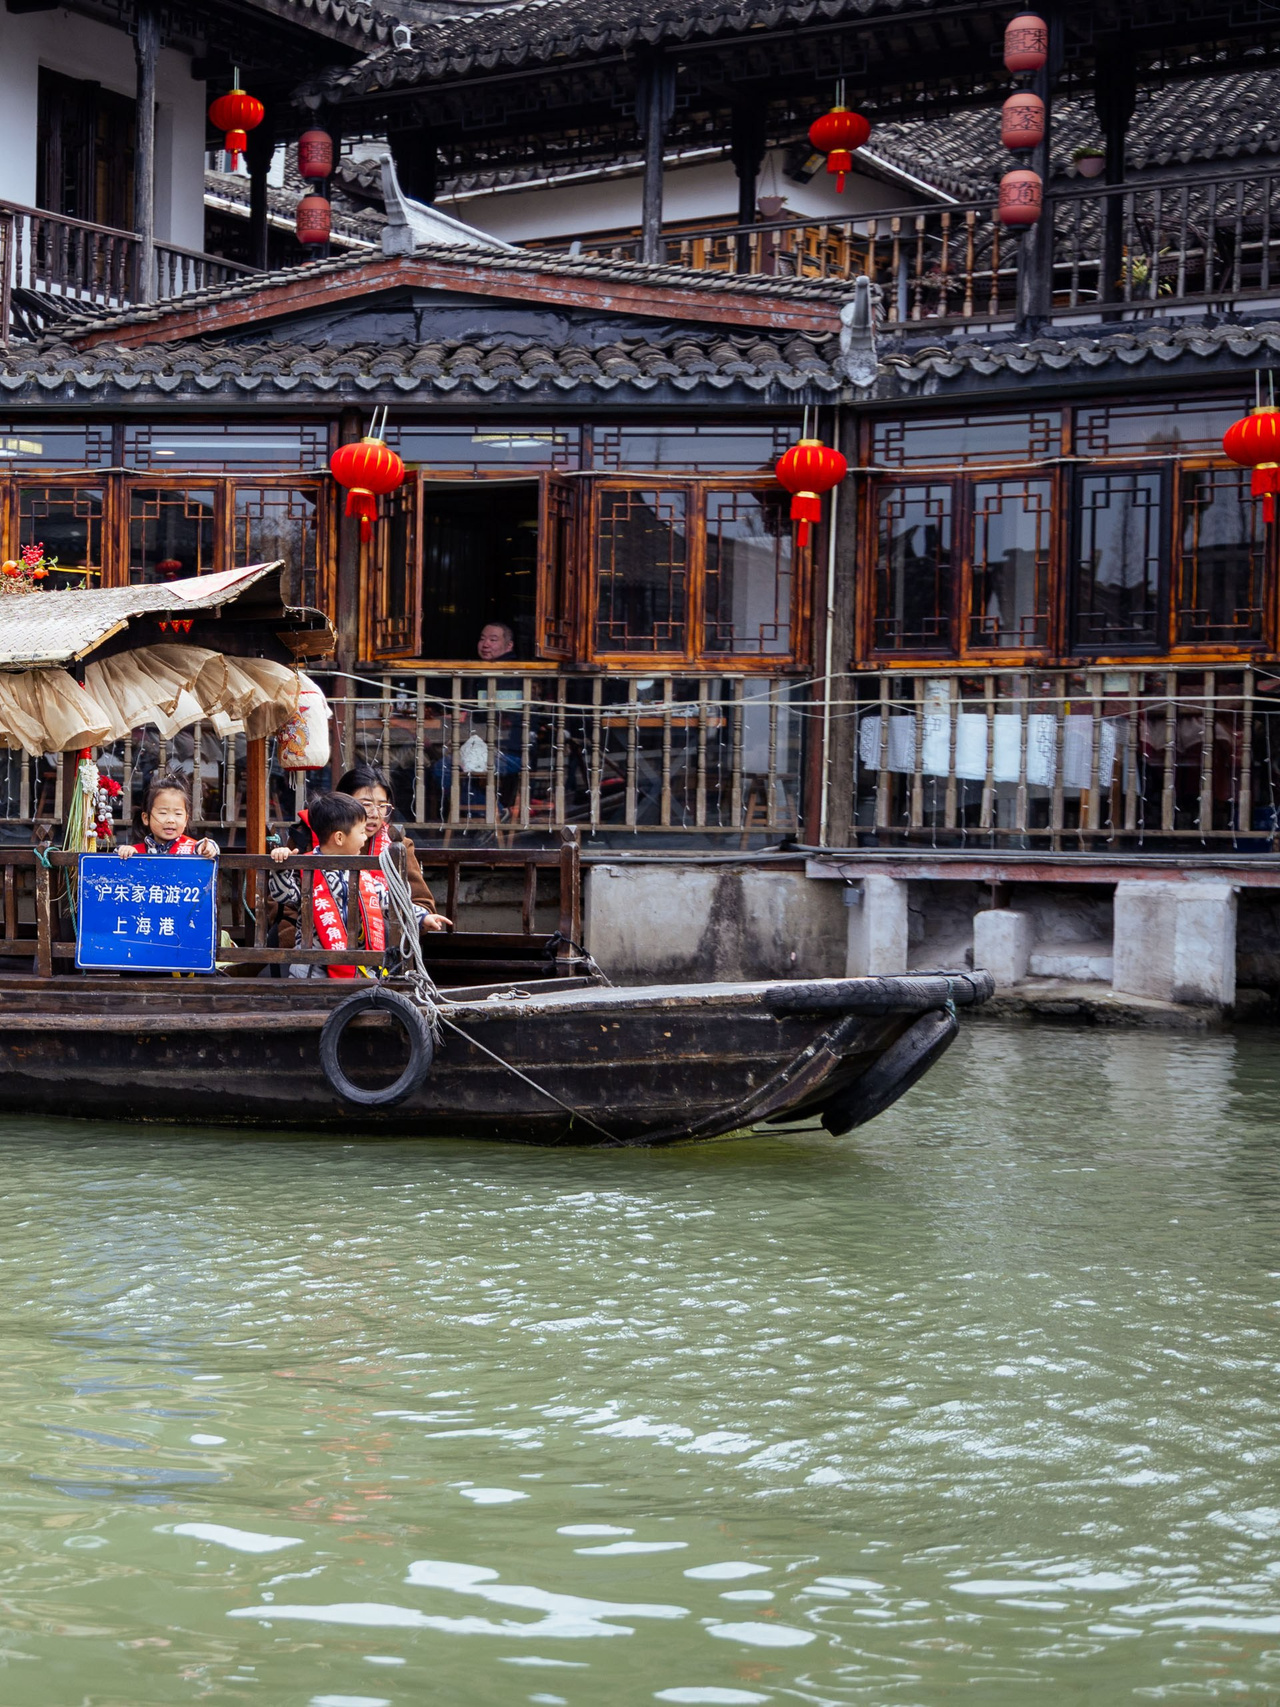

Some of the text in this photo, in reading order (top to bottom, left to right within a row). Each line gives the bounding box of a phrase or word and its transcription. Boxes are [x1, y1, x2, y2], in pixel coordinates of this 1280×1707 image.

[94, 884, 200, 904] 沪朱家角游22
[113, 916, 175, 936] 上海港
